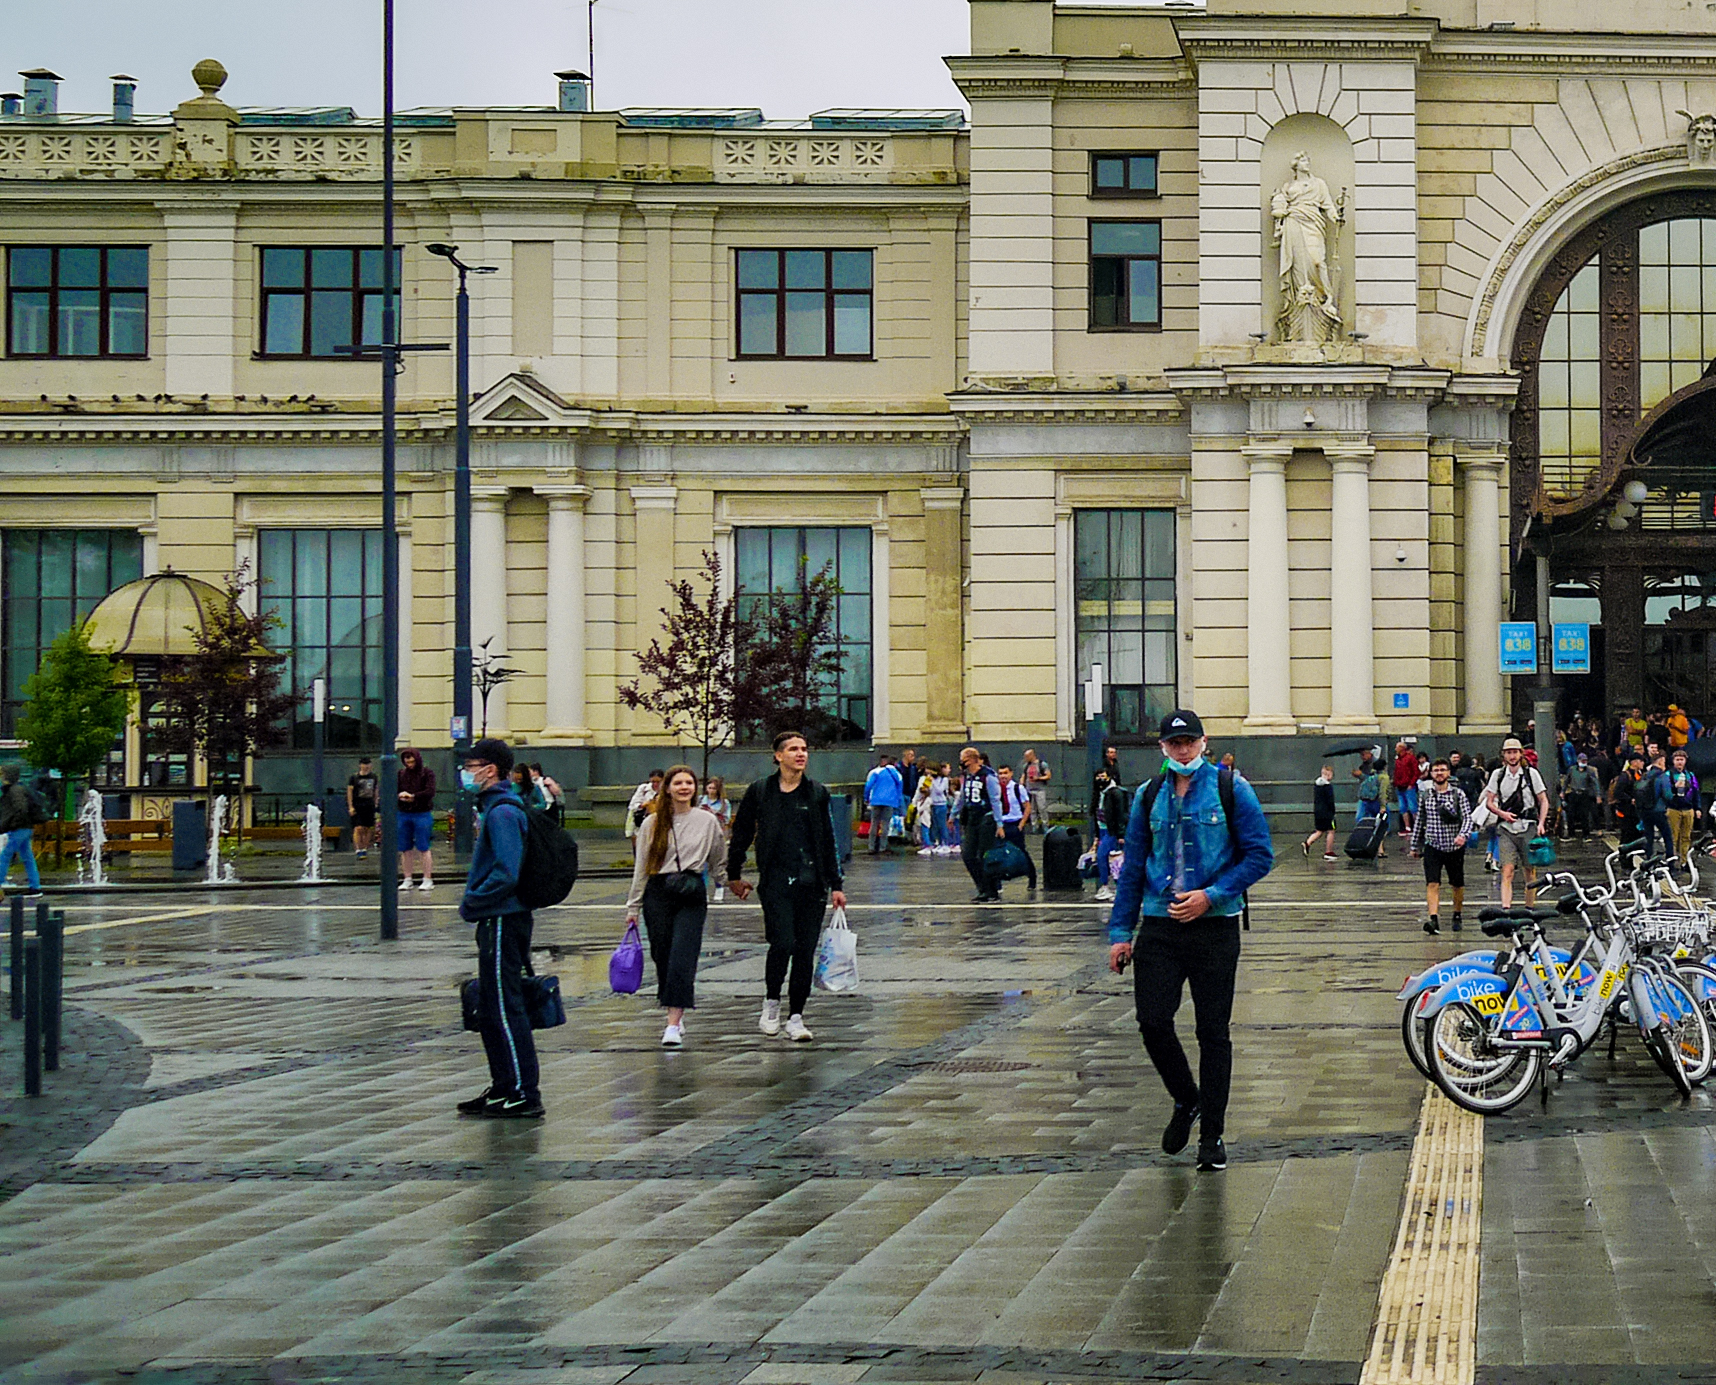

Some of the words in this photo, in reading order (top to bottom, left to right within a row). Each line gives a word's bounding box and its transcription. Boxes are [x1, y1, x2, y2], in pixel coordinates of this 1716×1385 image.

[1505, 638, 1532, 652] 838
[1558, 637, 1585, 651] 838
[1456, 980, 1496, 1000] bike
[1600, 972, 1613, 997] now
